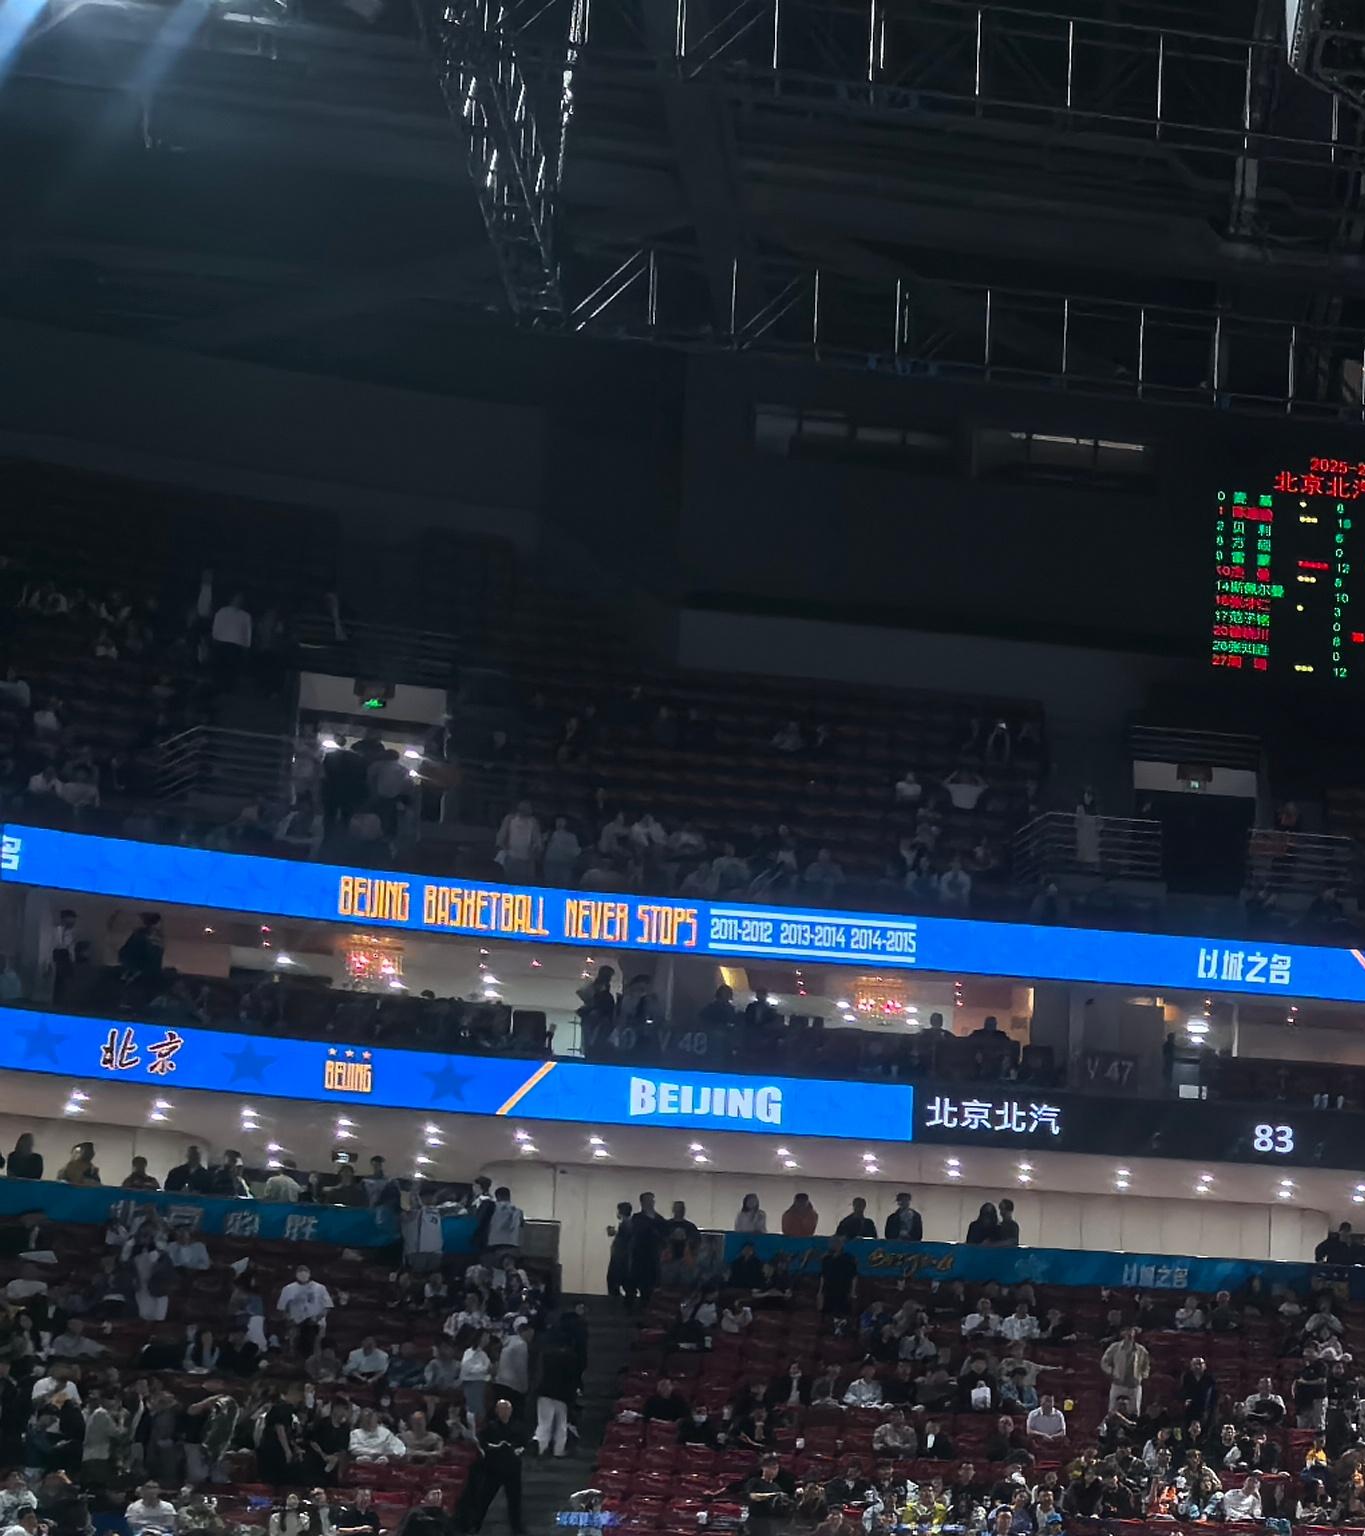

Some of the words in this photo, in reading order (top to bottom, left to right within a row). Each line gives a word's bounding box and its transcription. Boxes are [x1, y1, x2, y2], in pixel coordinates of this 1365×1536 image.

[338, 875, 410, 922] BEIJING
[423, 885, 550, 937] BASKETBALL
[565, 898, 630, 942] NEVER
[637, 904, 698, 948] STOPS
[710, 915, 773, 945] 2011-2012
[779, 919, 846, 948] 2013-2014
[850, 926, 918, 954] 2014-2015
[1197, 947, 1291, 986] 以城之名
[99, 1027, 185, 1076] 北京
[324, 1060, 373, 1093] BEIJING
[628, 1076, 783, 1125] BEIJING
[925, 1096, 1062, 1135] 北京北汽
[1253, 1122, 1295, 1154] 83
